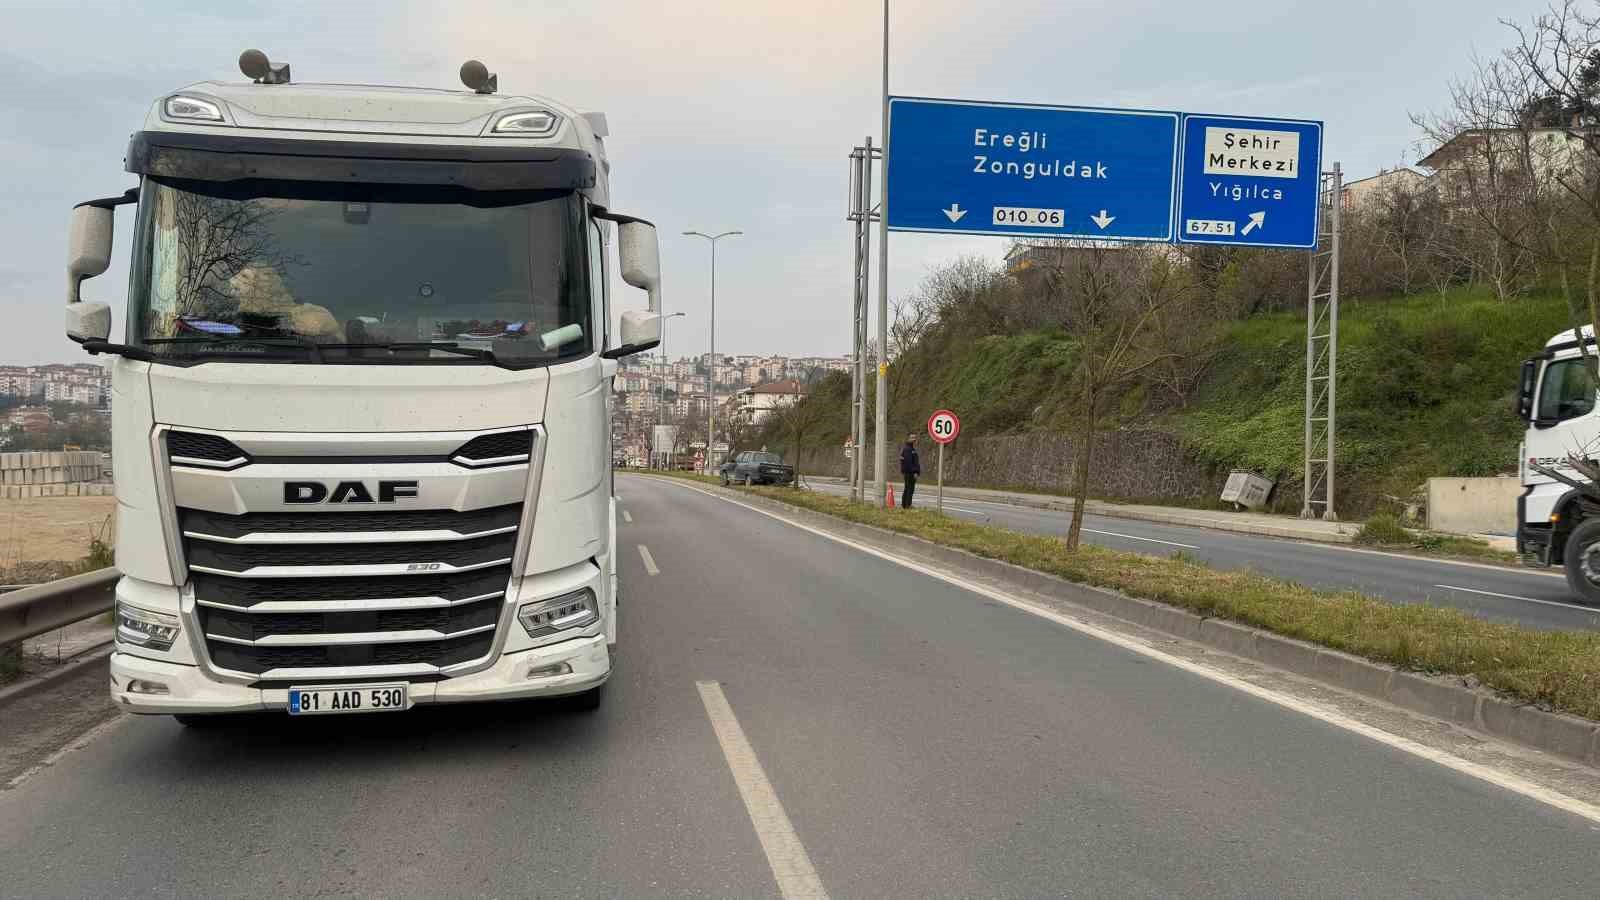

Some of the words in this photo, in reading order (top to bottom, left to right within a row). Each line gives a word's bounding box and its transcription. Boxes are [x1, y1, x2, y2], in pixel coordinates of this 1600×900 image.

[974, 128, 1047, 152] Ereğli
[1224, 132, 1281, 149] Şehir
[973, 155, 1109, 179] Zonguldak
[1209, 153, 1294, 172] Merkezi
[1209, 182, 1282, 201] Yığılca
[996, 209, 1060, 224] 010.06
[1191, 222, 1232, 233] 67.51
[935, 420, 952, 435] 50
[284, 481, 418, 503] DAF
[407, 563, 441, 571] 530
[301, 692, 319, 710] 81
[331, 691, 361, 709] AAD
[371, 689, 402, 707] 530
